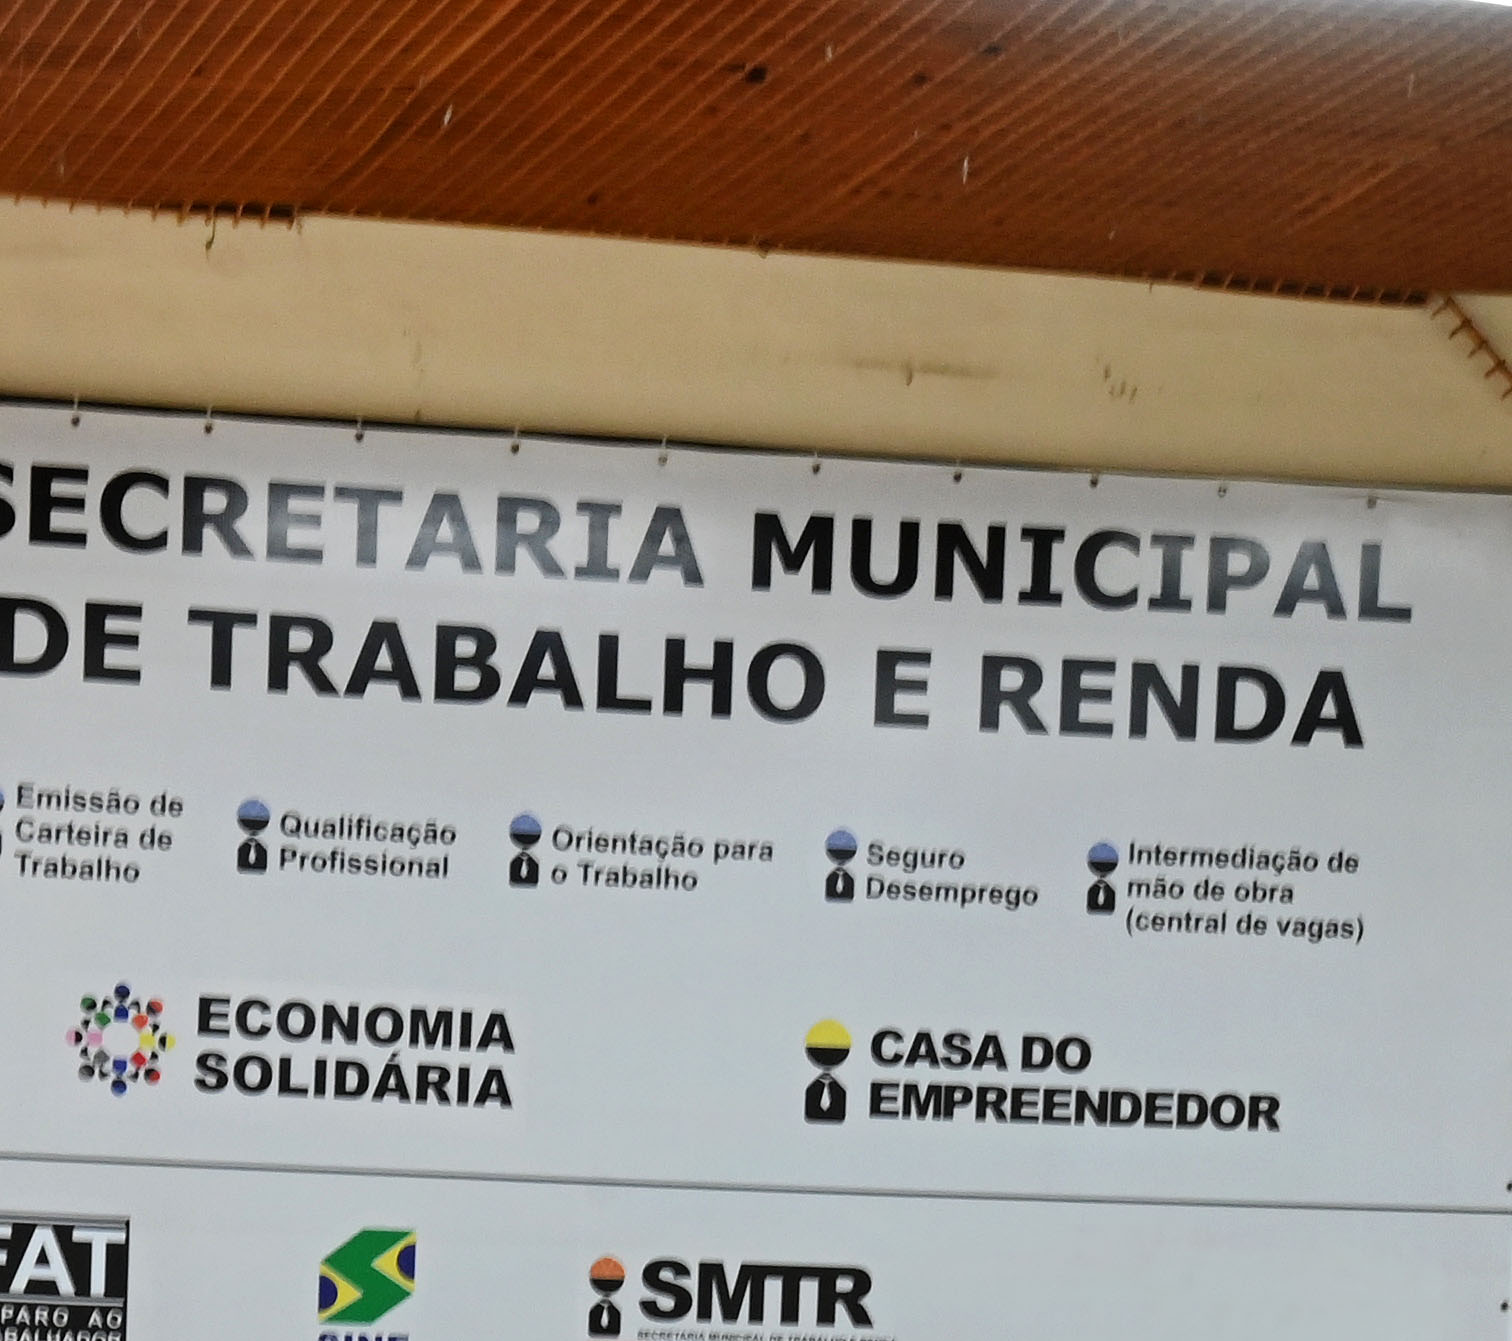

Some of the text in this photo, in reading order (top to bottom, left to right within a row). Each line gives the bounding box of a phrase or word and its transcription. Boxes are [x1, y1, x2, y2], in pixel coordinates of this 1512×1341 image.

[750, 512, 1415, 624] MUNICIPAL
[187, 602, 828, 725] TRABALHO
[872, 649, 933, 730] E
[977, 652, 1367, 752] RENDA
[16, 783, 185, 818] Emissão de
[14, 817, 173, 852] Carteira de
[279, 810, 458, 849] Qualificação
[551, 824, 775, 867] Orientação para
[13, 850, 141, 884] Trabalho
[278, 846, 450, 880] Profissional
[865, 841, 967, 875] Seguro
[1126, 841, 1361, 876] Intermediação de
[550, 861, 699, 893] o Trabalho
[864, 876, 1040, 911] Desemprego
[1126, 875, 1295, 907] mão de obra
[1125, 907, 1366, 944] (central de vagas)
[196, 994, 516, 1056] ECONOMIA
[869, 1027, 1093, 1075] CASA DO
[193, 1050, 514, 1110] SOLIDÁRIA
[869, 1079, 1282, 1133] EMPREENDEDOR
[638, 1257, 874, 1328] SMTR
[88, 1307, 123, 1330] AO
